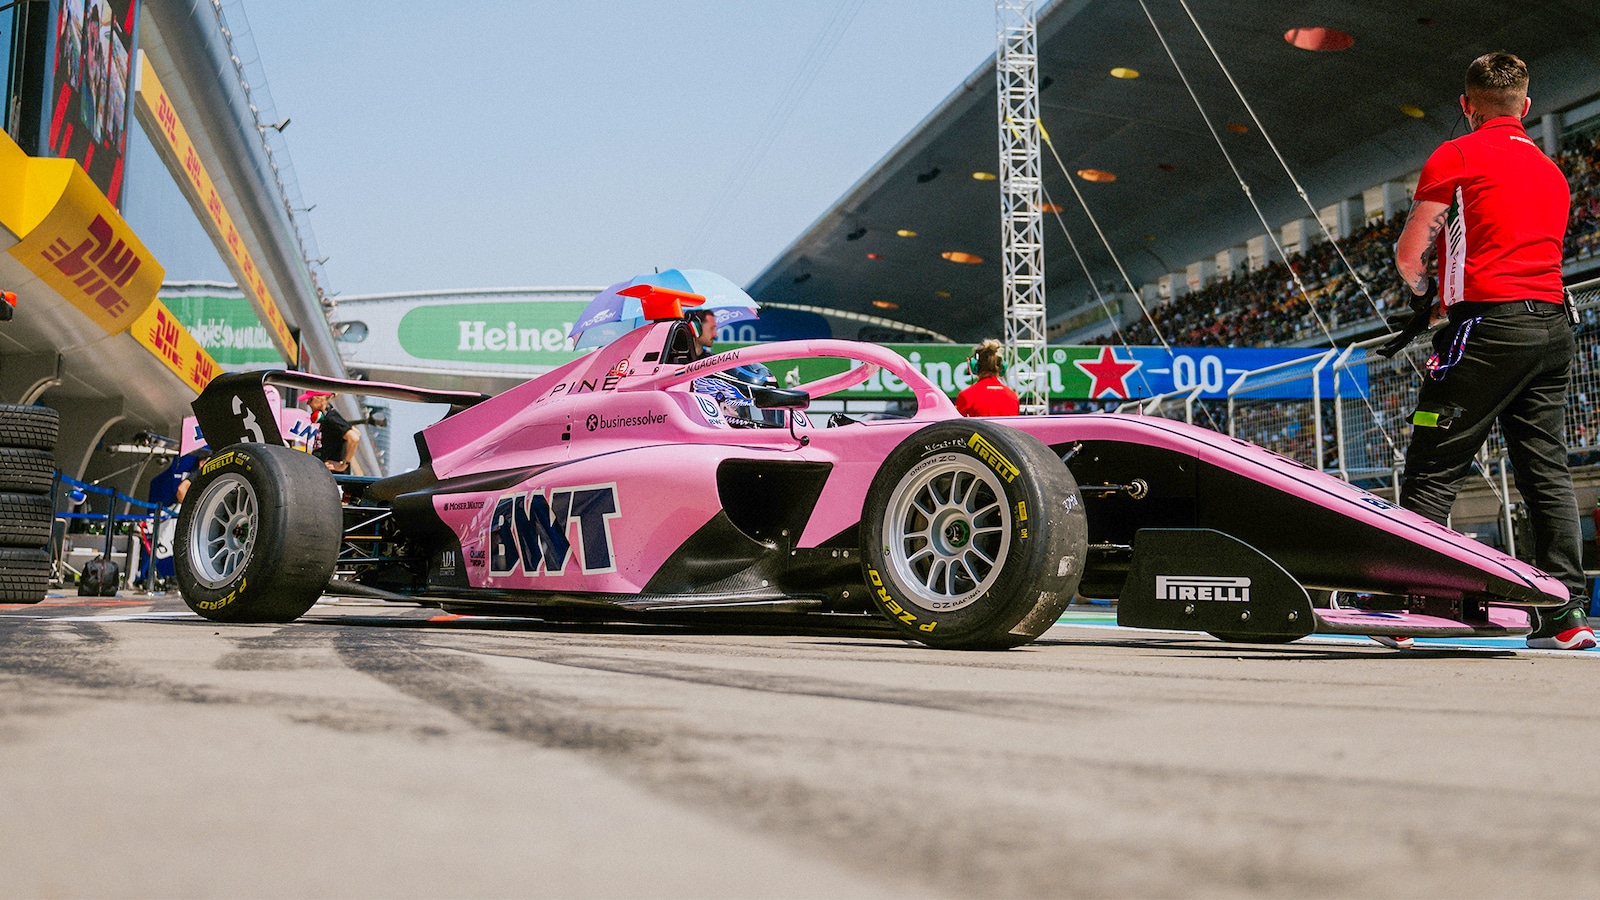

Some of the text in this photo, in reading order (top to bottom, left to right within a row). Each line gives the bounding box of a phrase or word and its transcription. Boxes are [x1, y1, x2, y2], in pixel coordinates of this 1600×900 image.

[53, 213, 141, 310] DHL
[154, 309, 180, 366] DHL
[536, 377, 620, 402] PINE
[847, 352, 1065, 392] Heineen
[600, 410, 668, 429] businessolver
[202, 451, 235, 476] PIRELLI
[967, 432, 1020, 483] PIRELLI
[489, 481, 622, 577] BWT
[199, 577, 248, 611] P ZERO
[868, 569, 938, 633] P ZERO
[1155, 575, 1252, 602] PIRELLI
